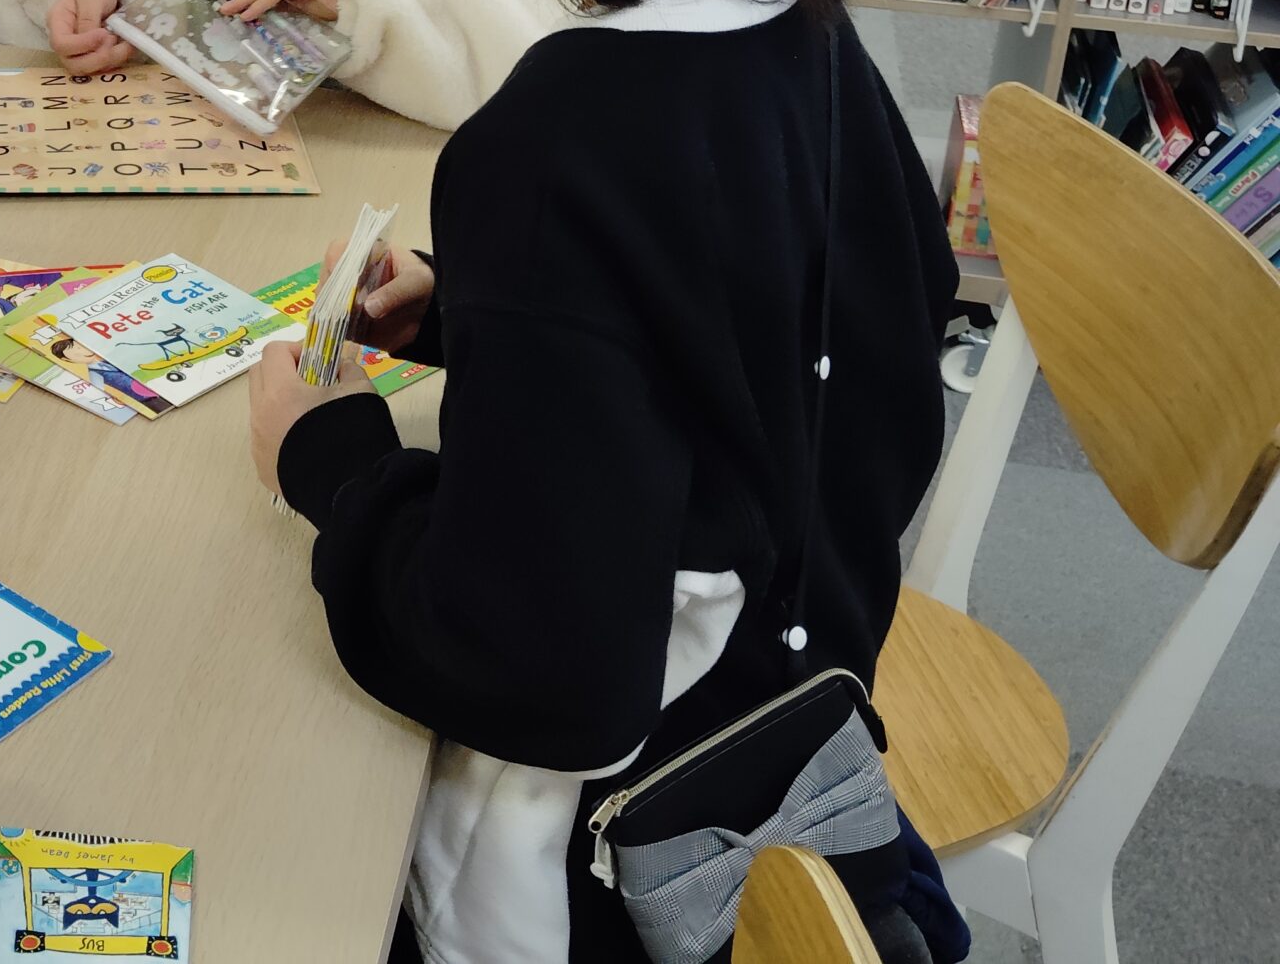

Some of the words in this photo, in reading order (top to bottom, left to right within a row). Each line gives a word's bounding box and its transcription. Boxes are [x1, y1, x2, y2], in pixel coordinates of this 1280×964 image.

[40, 75, 66, 86] N
[42, 96, 69, 110] M
[104, 94, 130, 106] R
[165, 90, 194, 106] W
[45, 120, 71, 132] L
[106, 117, 134, 132] Q
[169, 115, 198, 127] V
[46, 143, 74, 155] K
[110, 141, 139, 154] P
[175, 138, 204, 150] U
[239, 139, 268, 152] Z
[48, 166, 76, 177] J
[114, 162, 142, 176] O
[179, 163, 208, 176] T
[246, 163, 274, 177] Y
[1230, 169, 1258, 197] Farm
[270, 281, 298, 298] Readers
[85, 308, 91, 317] I
[91, 296, 118, 314] Can
[118, 280, 148, 302] Read!
[184, 299, 207, 314] FISH
[207, 291, 229, 306] ARE
[86, 309, 154, 340] Pete
[140, 296, 160, 309] the
[161, 279, 215, 306] Cat
[205, 303, 228, 316] FUN
[67, 651, 93, 672] First
[40, 667, 72, 691] Little
[0, 684, 44, 720] Readers
[40, 847, 71, 860] Dean
[75, 849, 115, 864] James
[119, 856, 135, 865] by
[78, 937, 106, 952] BUS
